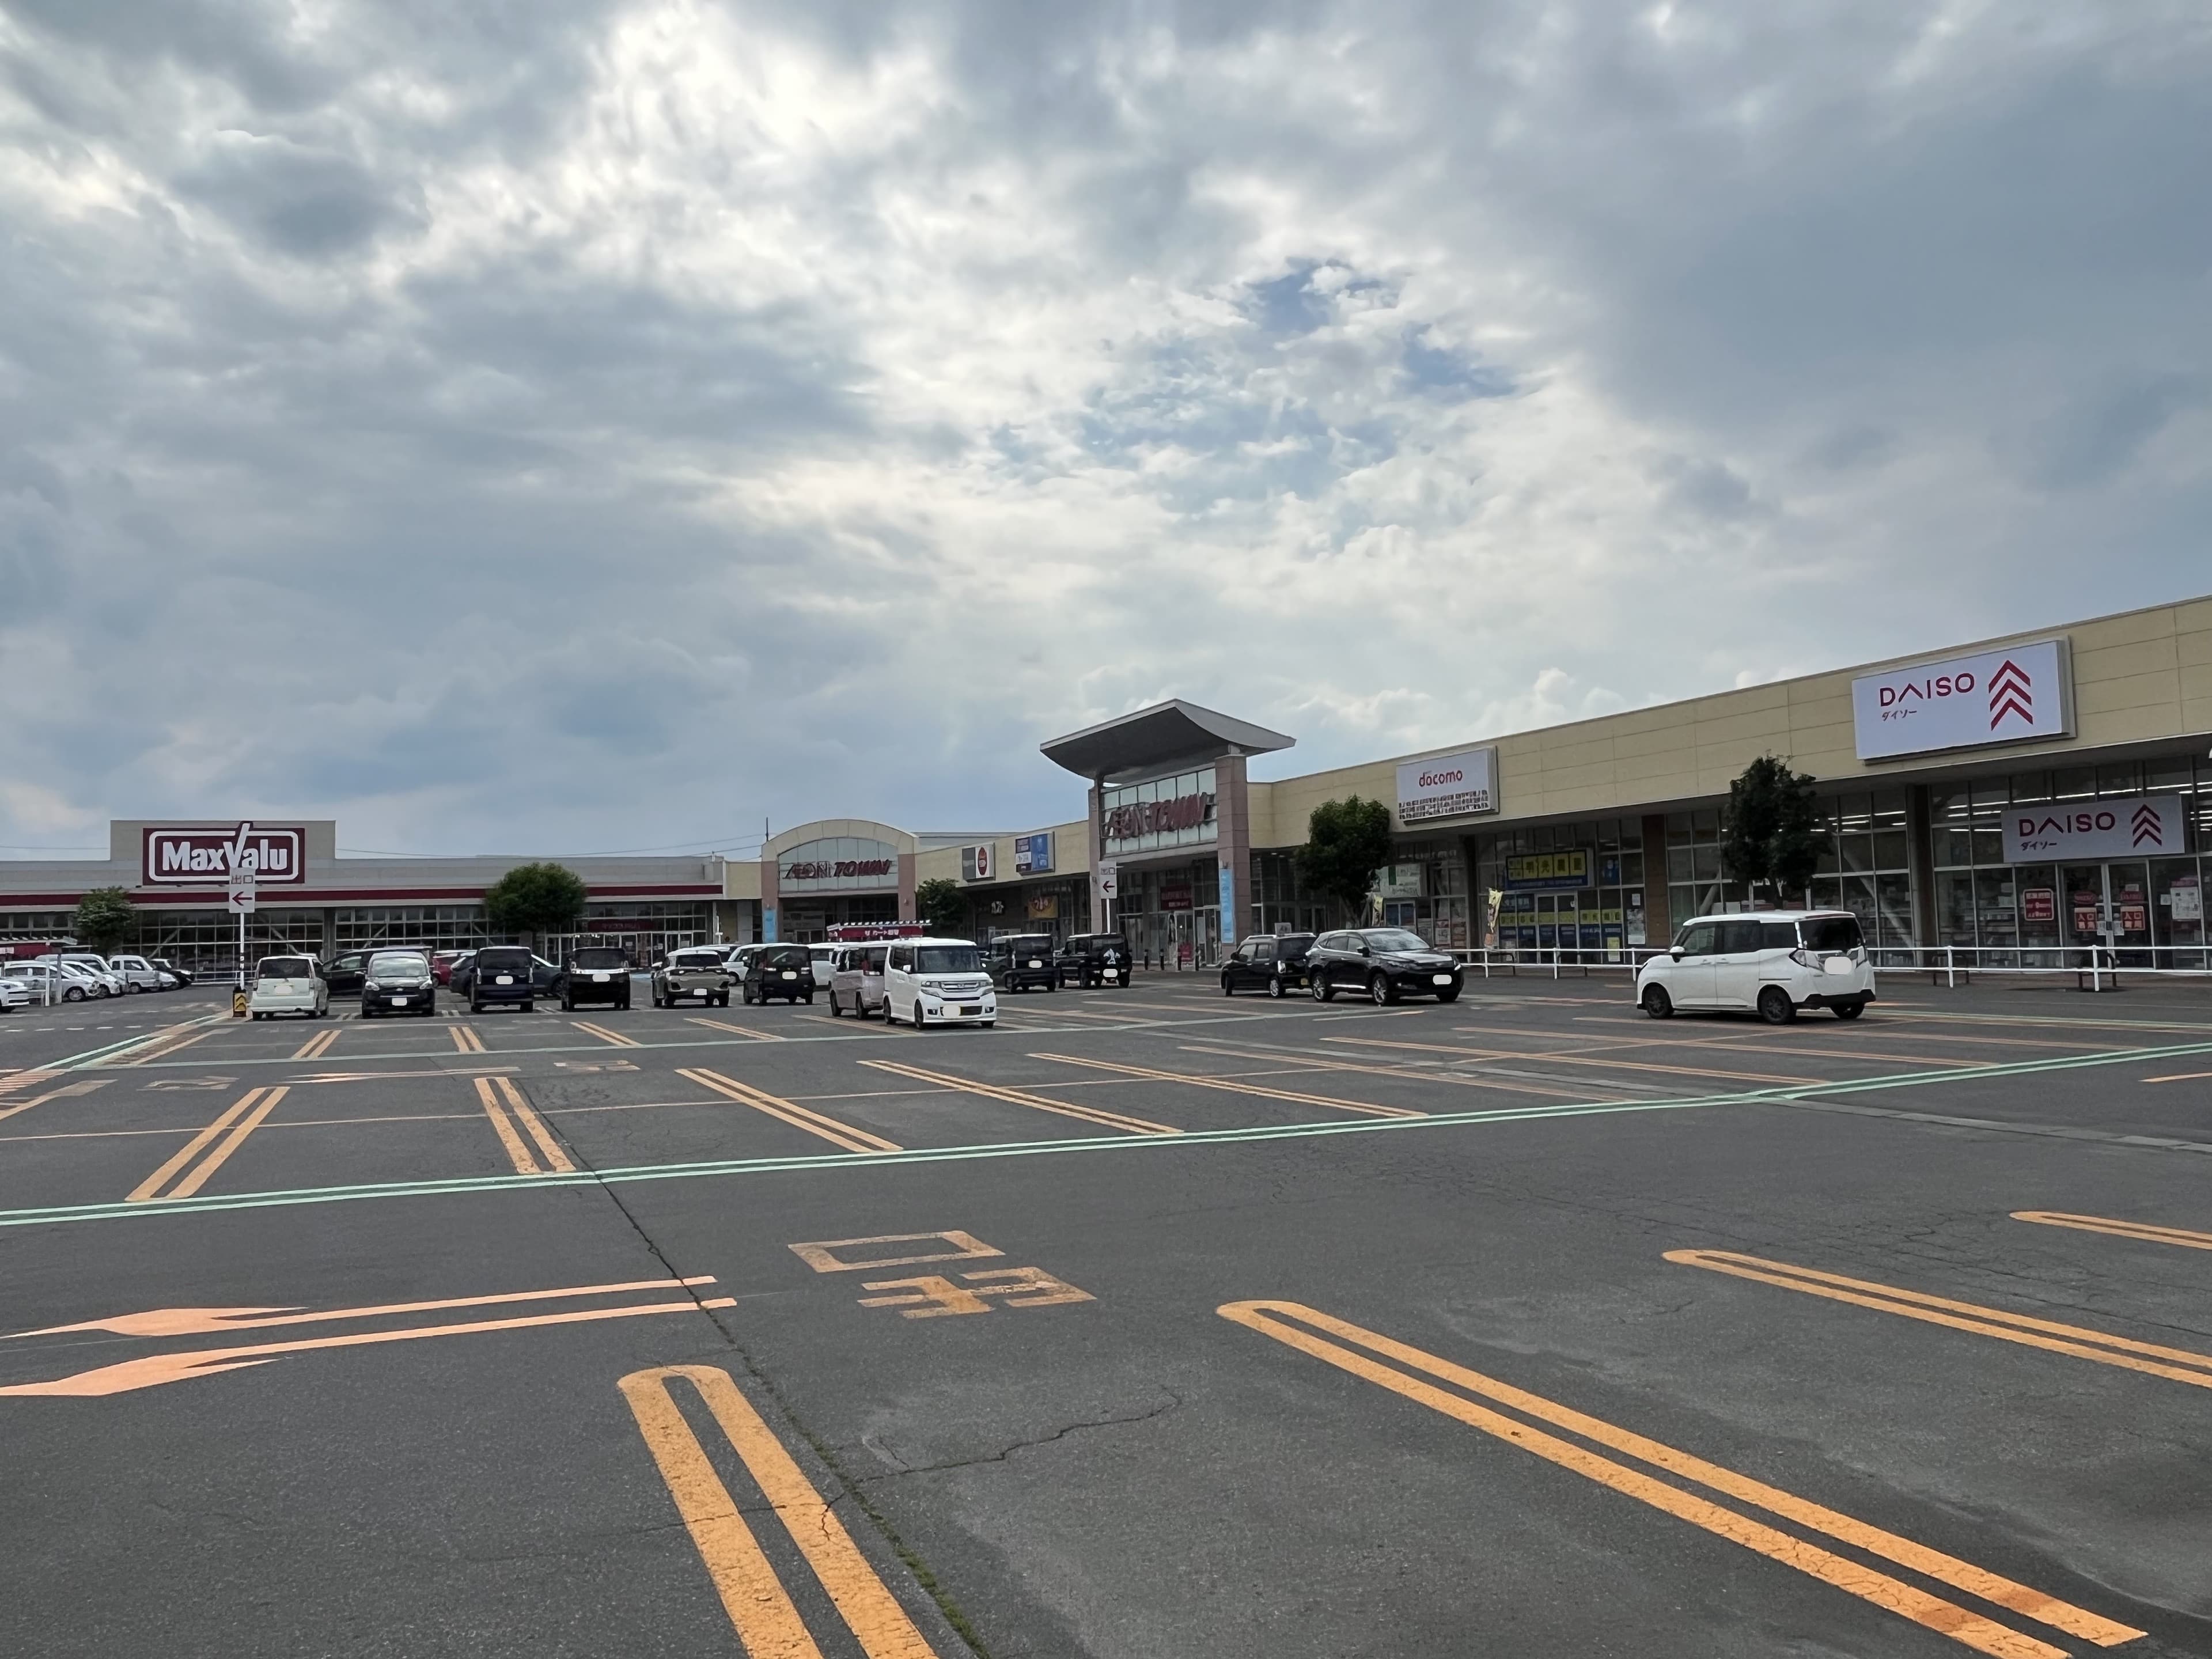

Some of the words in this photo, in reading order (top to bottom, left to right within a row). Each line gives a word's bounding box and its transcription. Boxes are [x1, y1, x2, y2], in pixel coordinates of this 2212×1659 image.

[1880, 672, 1975, 707] DAISO
[1881, 709, 1918, 722] ダイソー
[1419, 770, 1463, 787] docomo
[2019, 812, 2115, 838] DAISO
[162, 823, 287, 871] MaxValu
[2021, 841, 2058, 852] ダイソー
[231, 874, 253, 885] 出口
